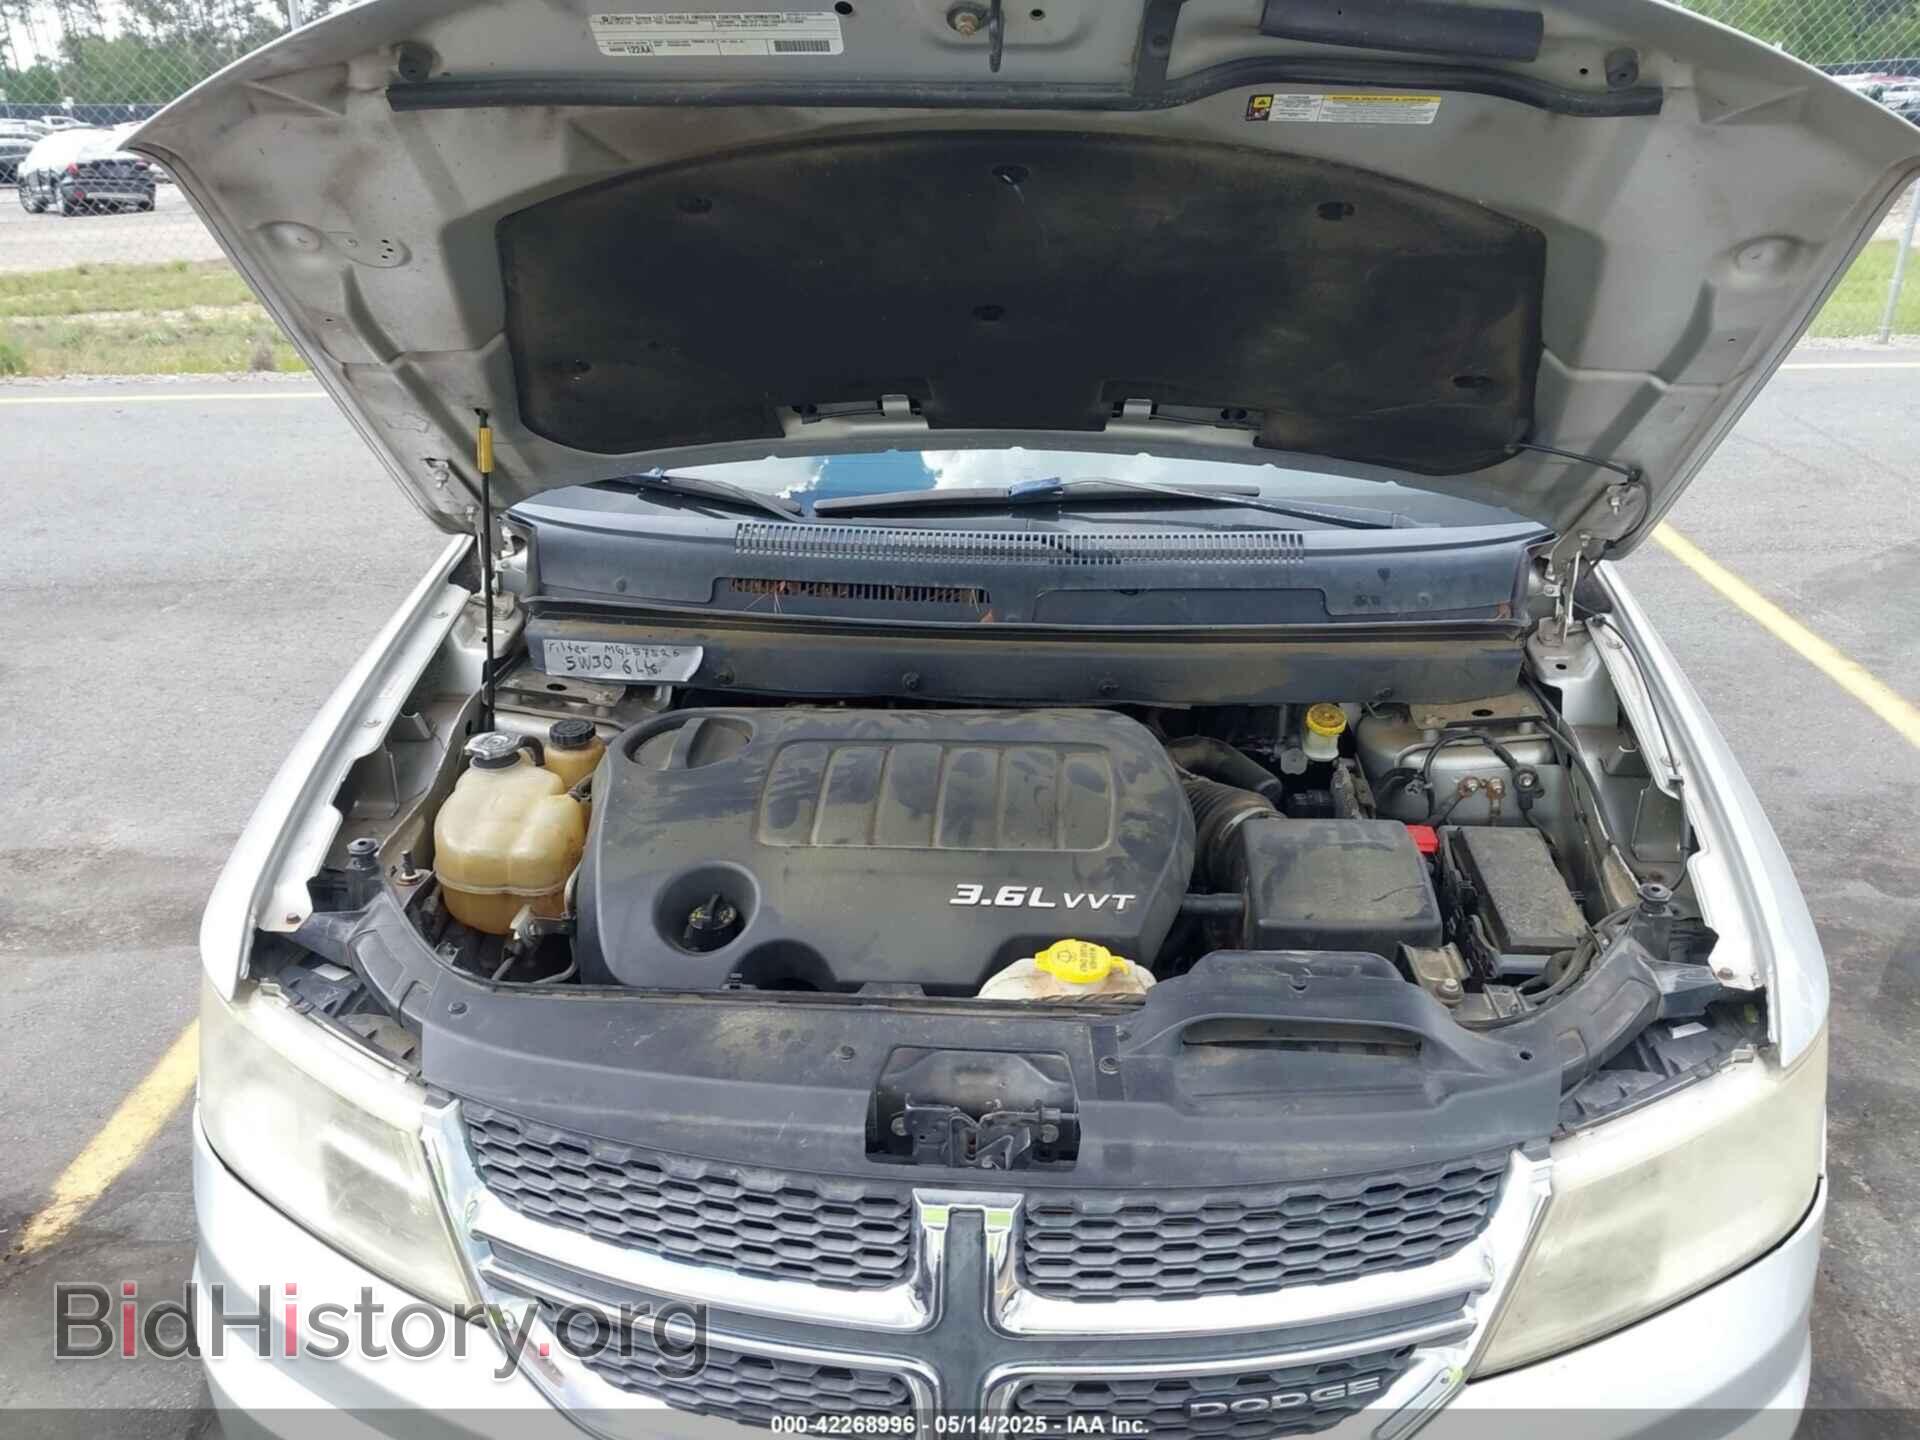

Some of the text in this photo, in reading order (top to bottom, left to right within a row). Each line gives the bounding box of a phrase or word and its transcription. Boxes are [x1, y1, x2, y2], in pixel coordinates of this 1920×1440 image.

[564, 654, 613, 671] 5W30
[949, 883, 1137, 910] 3.6L VVT
[1190, 1376, 1381, 1418] DODGE
